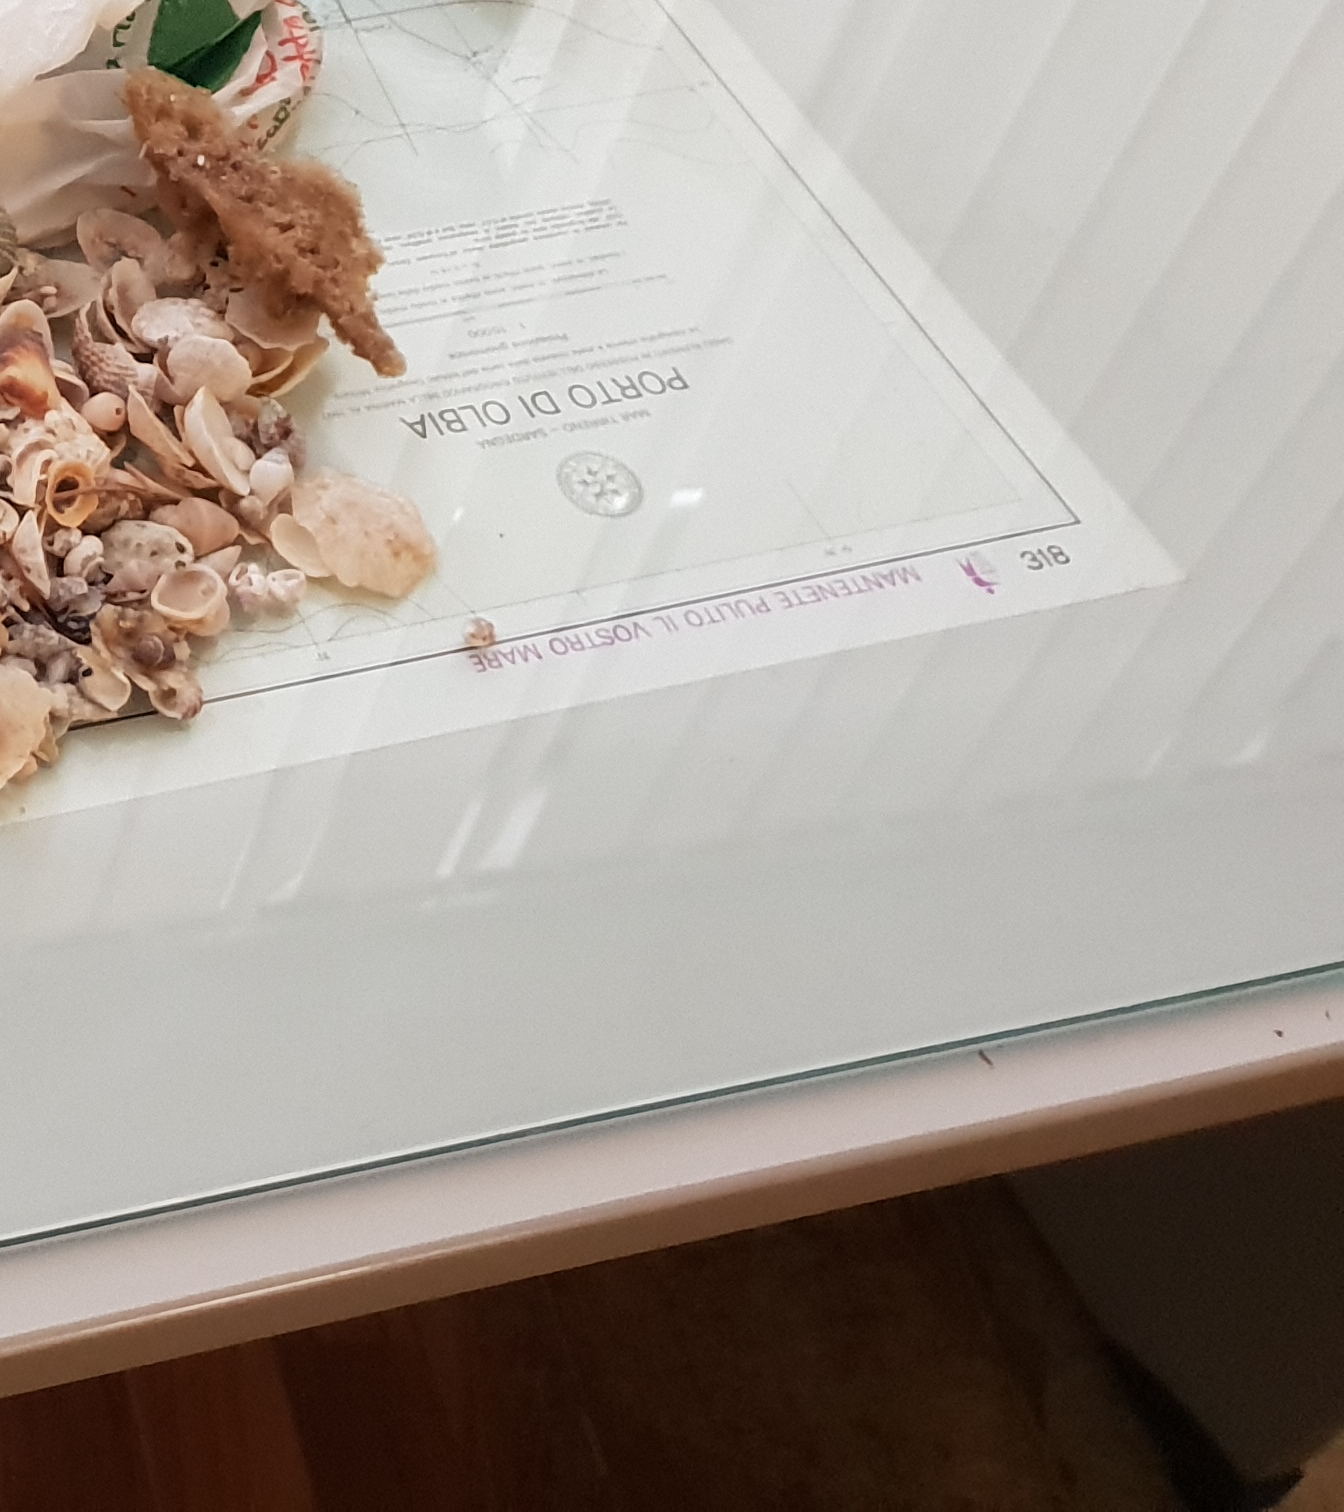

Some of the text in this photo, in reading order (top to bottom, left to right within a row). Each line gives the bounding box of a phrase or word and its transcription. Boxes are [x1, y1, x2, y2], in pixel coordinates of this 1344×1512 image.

[517, 390, 562, 419] DI
[567, 366, 691, 409] PORTO
[398, 399, 512, 439] OLBIA
[1019, 543, 1072, 572] 318
[468, 563, 923, 674] MANTENETE PULITO IL VOSTRO MARE
